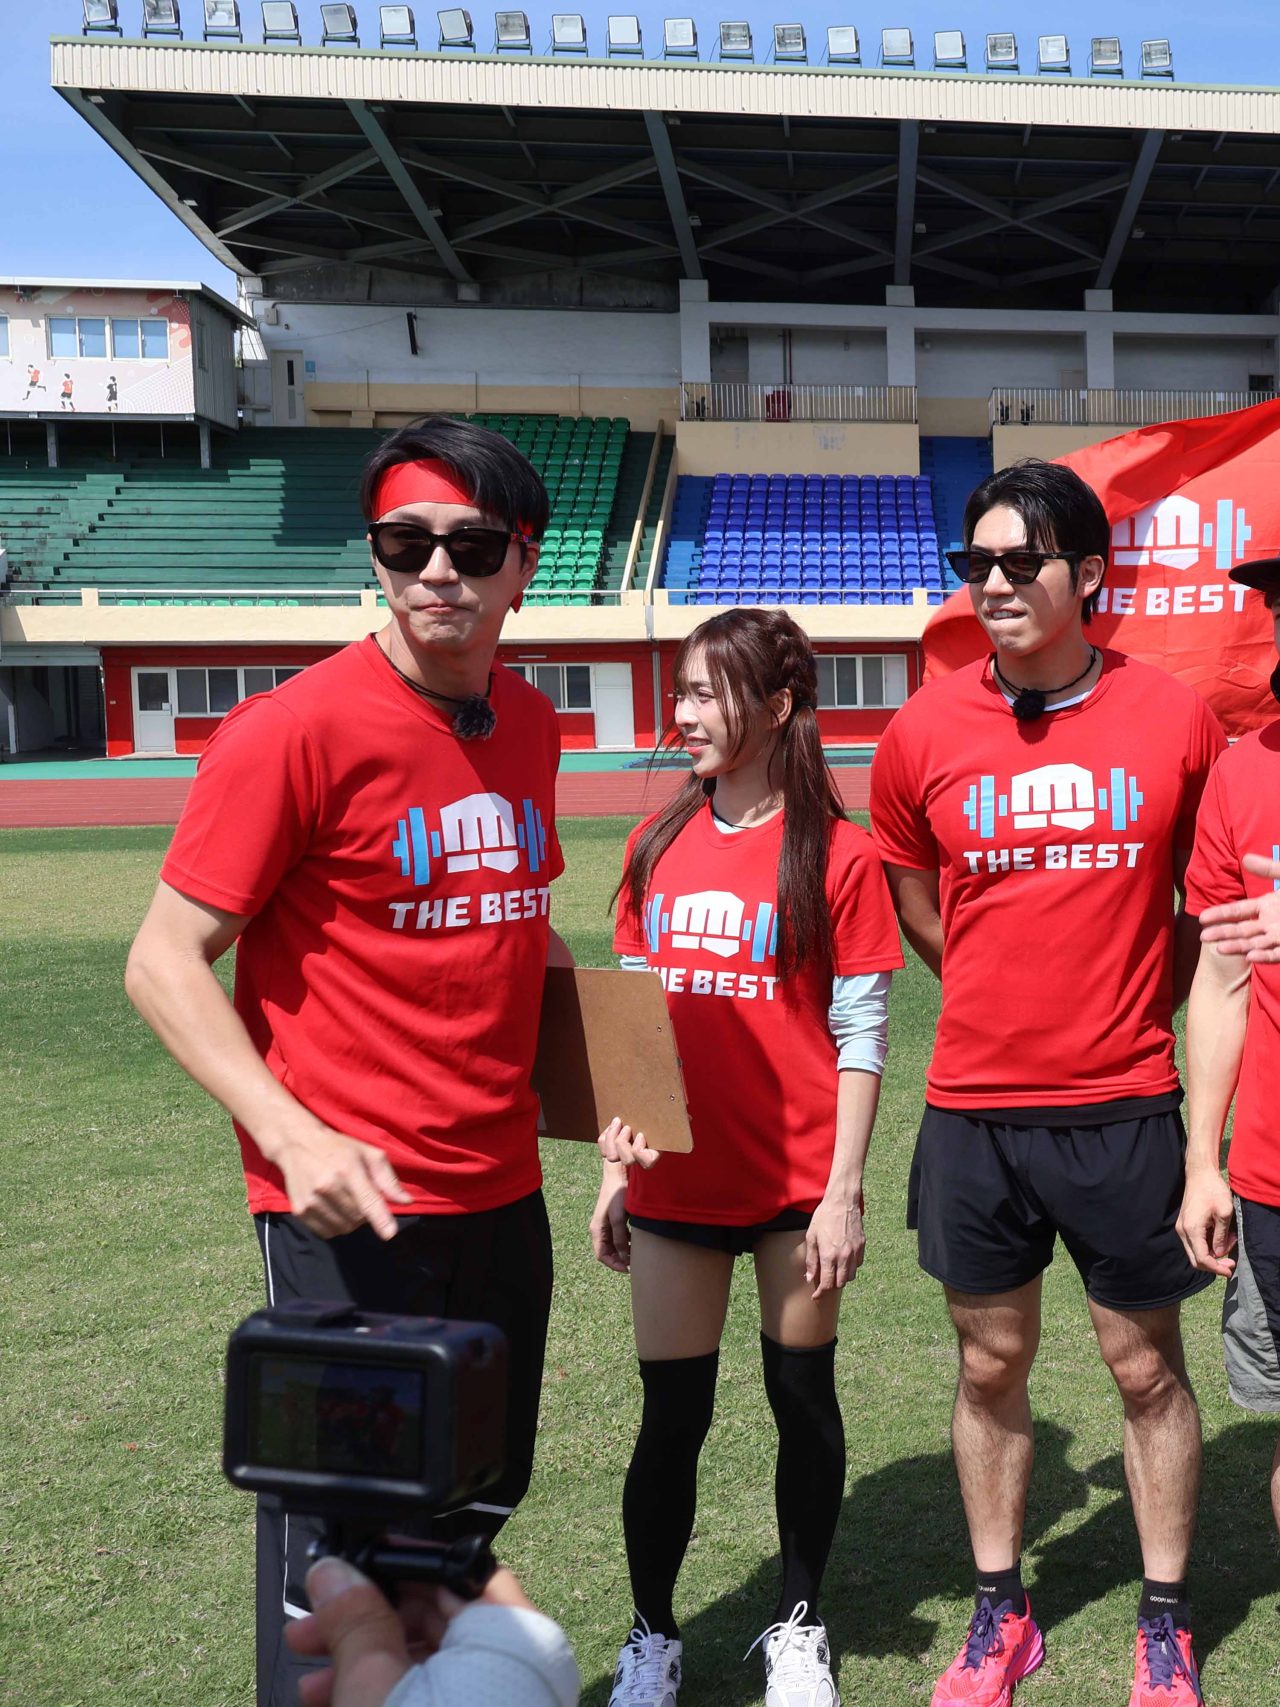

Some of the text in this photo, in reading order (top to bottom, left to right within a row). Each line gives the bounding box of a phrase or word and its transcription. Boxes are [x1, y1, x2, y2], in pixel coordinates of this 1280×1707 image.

[1091, 584, 1251, 616] HE BEST
[962, 842, 1145, 874] THE BEST
[388, 887, 550, 930] THE BEST
[691, 969, 780, 1001] BEST
